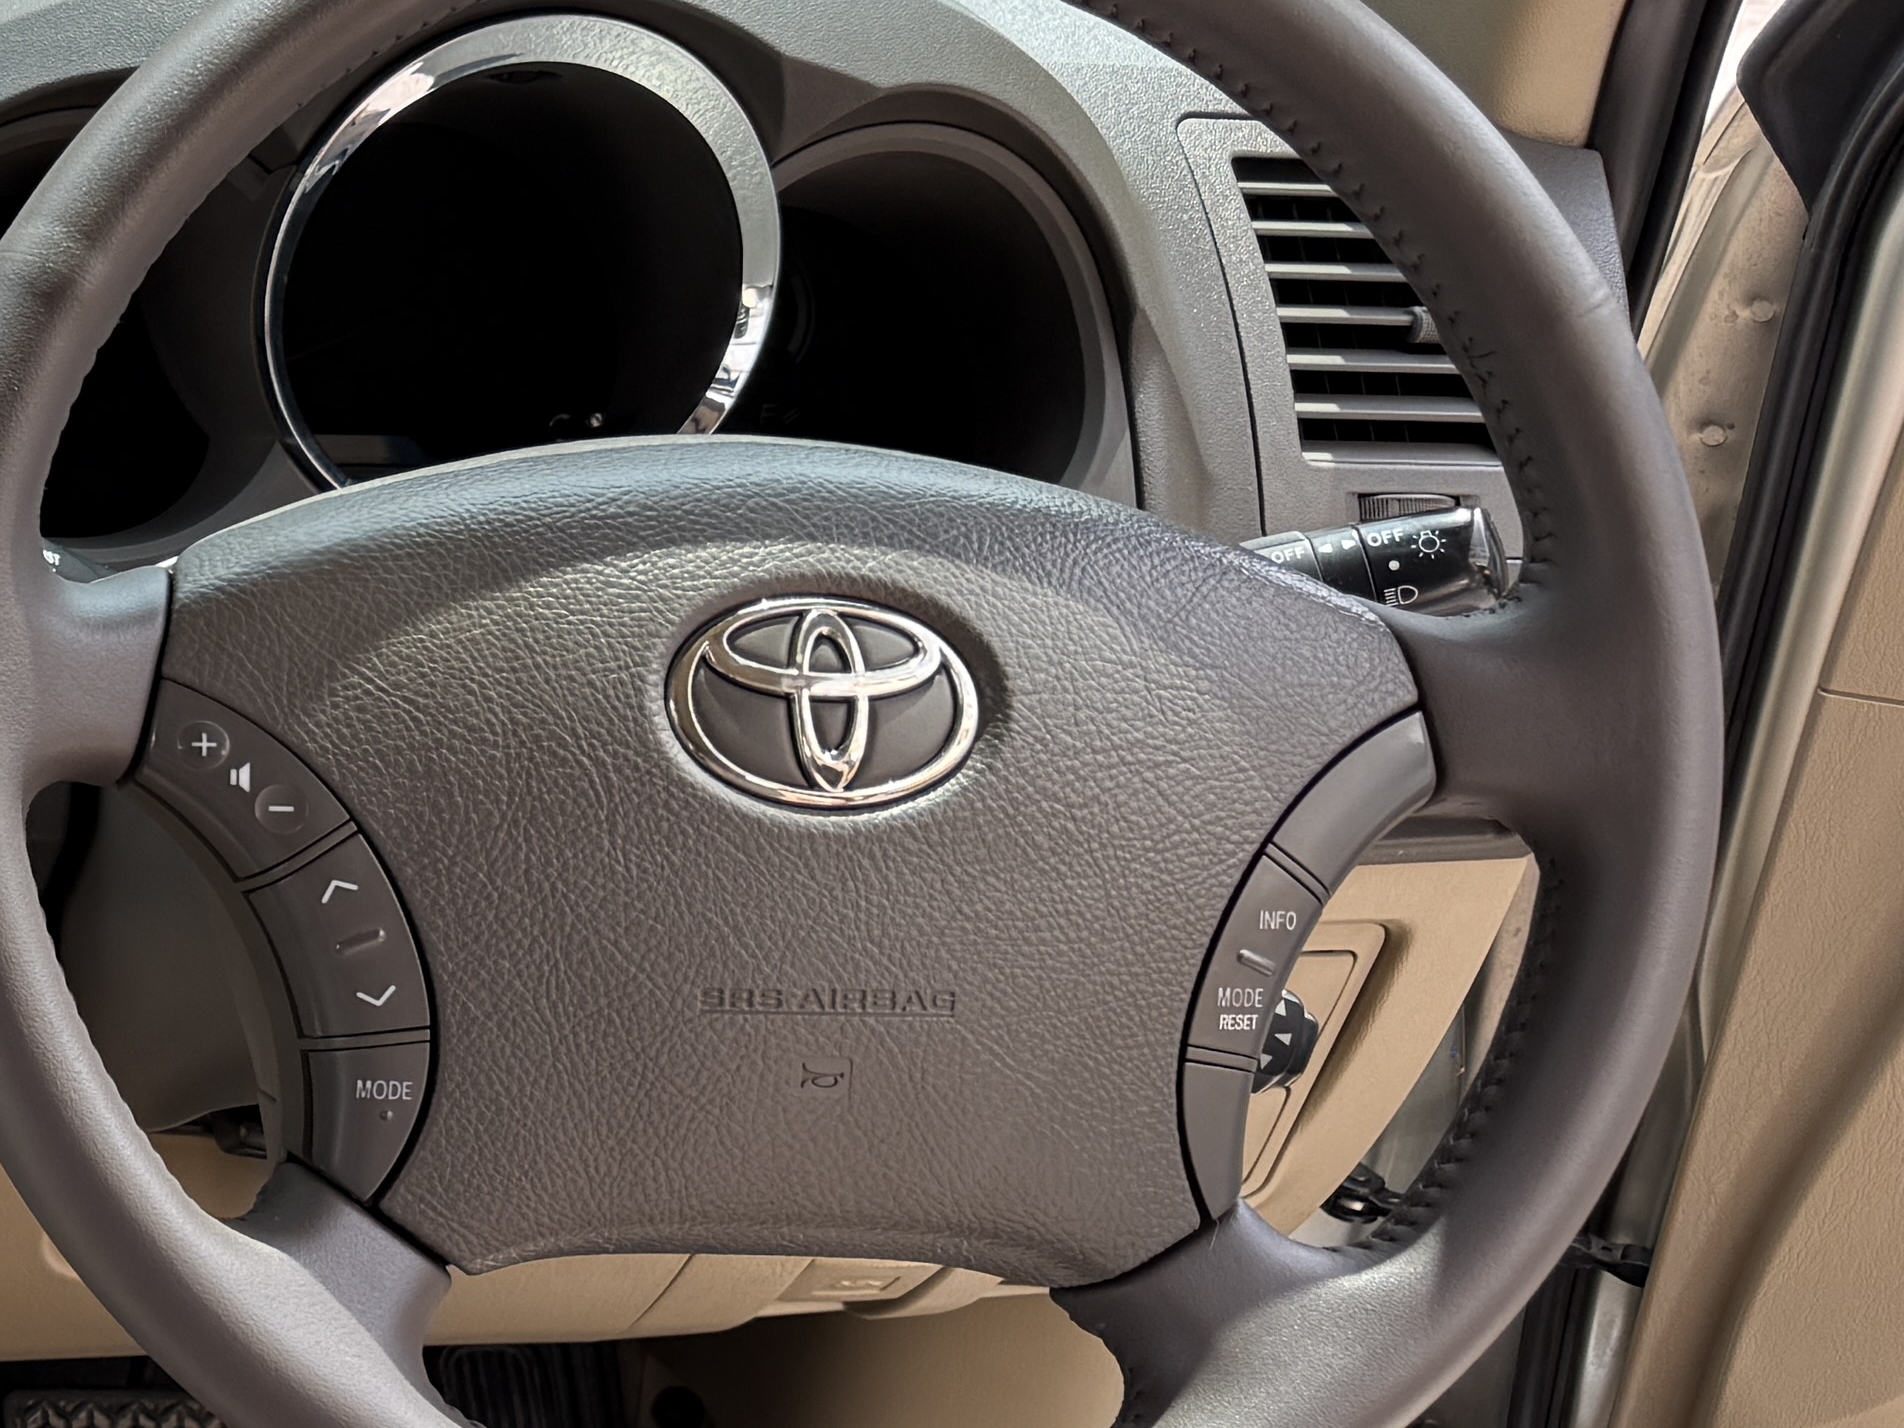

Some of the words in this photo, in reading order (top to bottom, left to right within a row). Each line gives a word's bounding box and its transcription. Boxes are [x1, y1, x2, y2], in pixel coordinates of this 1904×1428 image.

[1367, 529, 1405, 548] OFF
[1270, 546, 1305, 565] OFF
[1258, 910, 1297, 931] INFO
[699, 986, 784, 1010] SRS
[798, 986, 956, 1012] AIRBAG
[1217, 987, 1264, 1008] MODE
[1219, 1013, 1258, 1031] RESET
[355, 1078, 413, 1101] MODE
